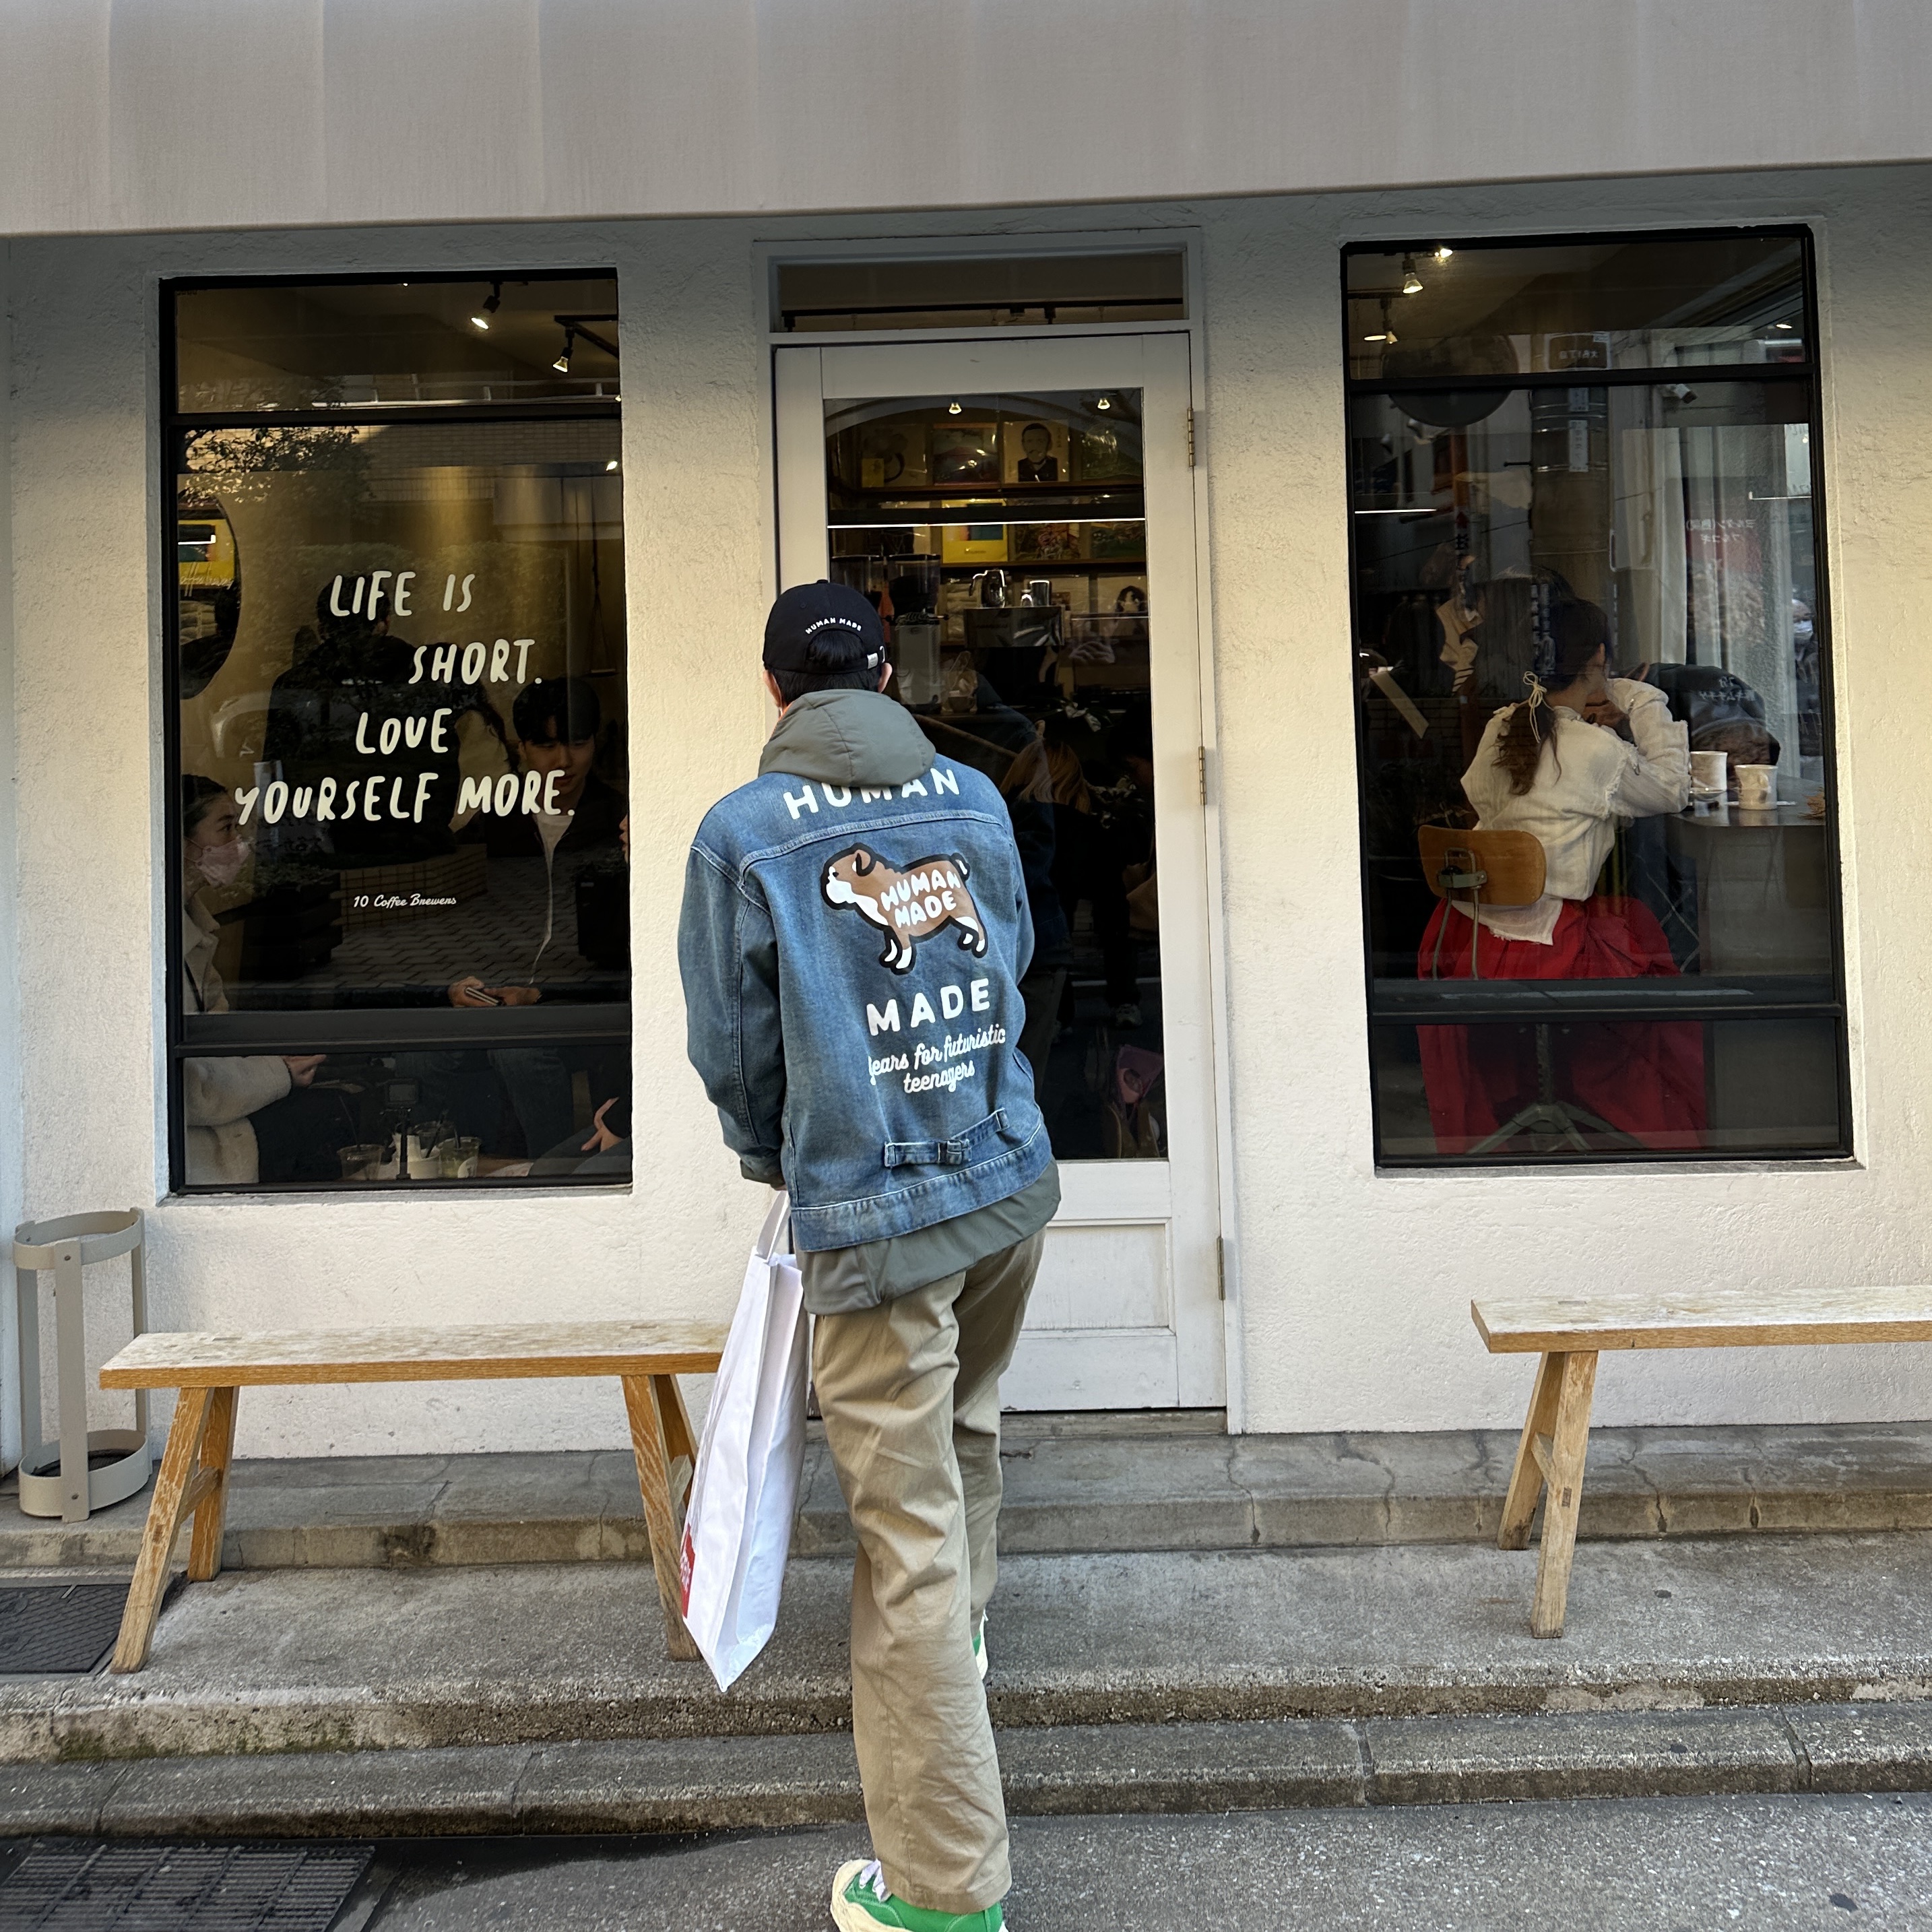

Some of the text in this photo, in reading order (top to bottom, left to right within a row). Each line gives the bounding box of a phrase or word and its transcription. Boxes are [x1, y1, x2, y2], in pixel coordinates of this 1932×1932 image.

[330, 571, 476, 621] LIFE IS
[805, 617, 862, 635] HUMAN MADE
[408, 639, 542, 685] SHORT.
[356, 708, 453, 756] LOVE
[235, 770, 575, 826] YOURSELF MORE.
[354, 893, 457, 909] 10 Coffee Brewers
[880, 869, 961, 911] HUMAN
[895, 891, 957, 928] MADE
[866, 977, 990, 1036] MADE
[914, 1043, 943, 1070] for
[943, 1023, 1006, 1062] futuristic
[903, 1060, 975, 1093] teenagers
